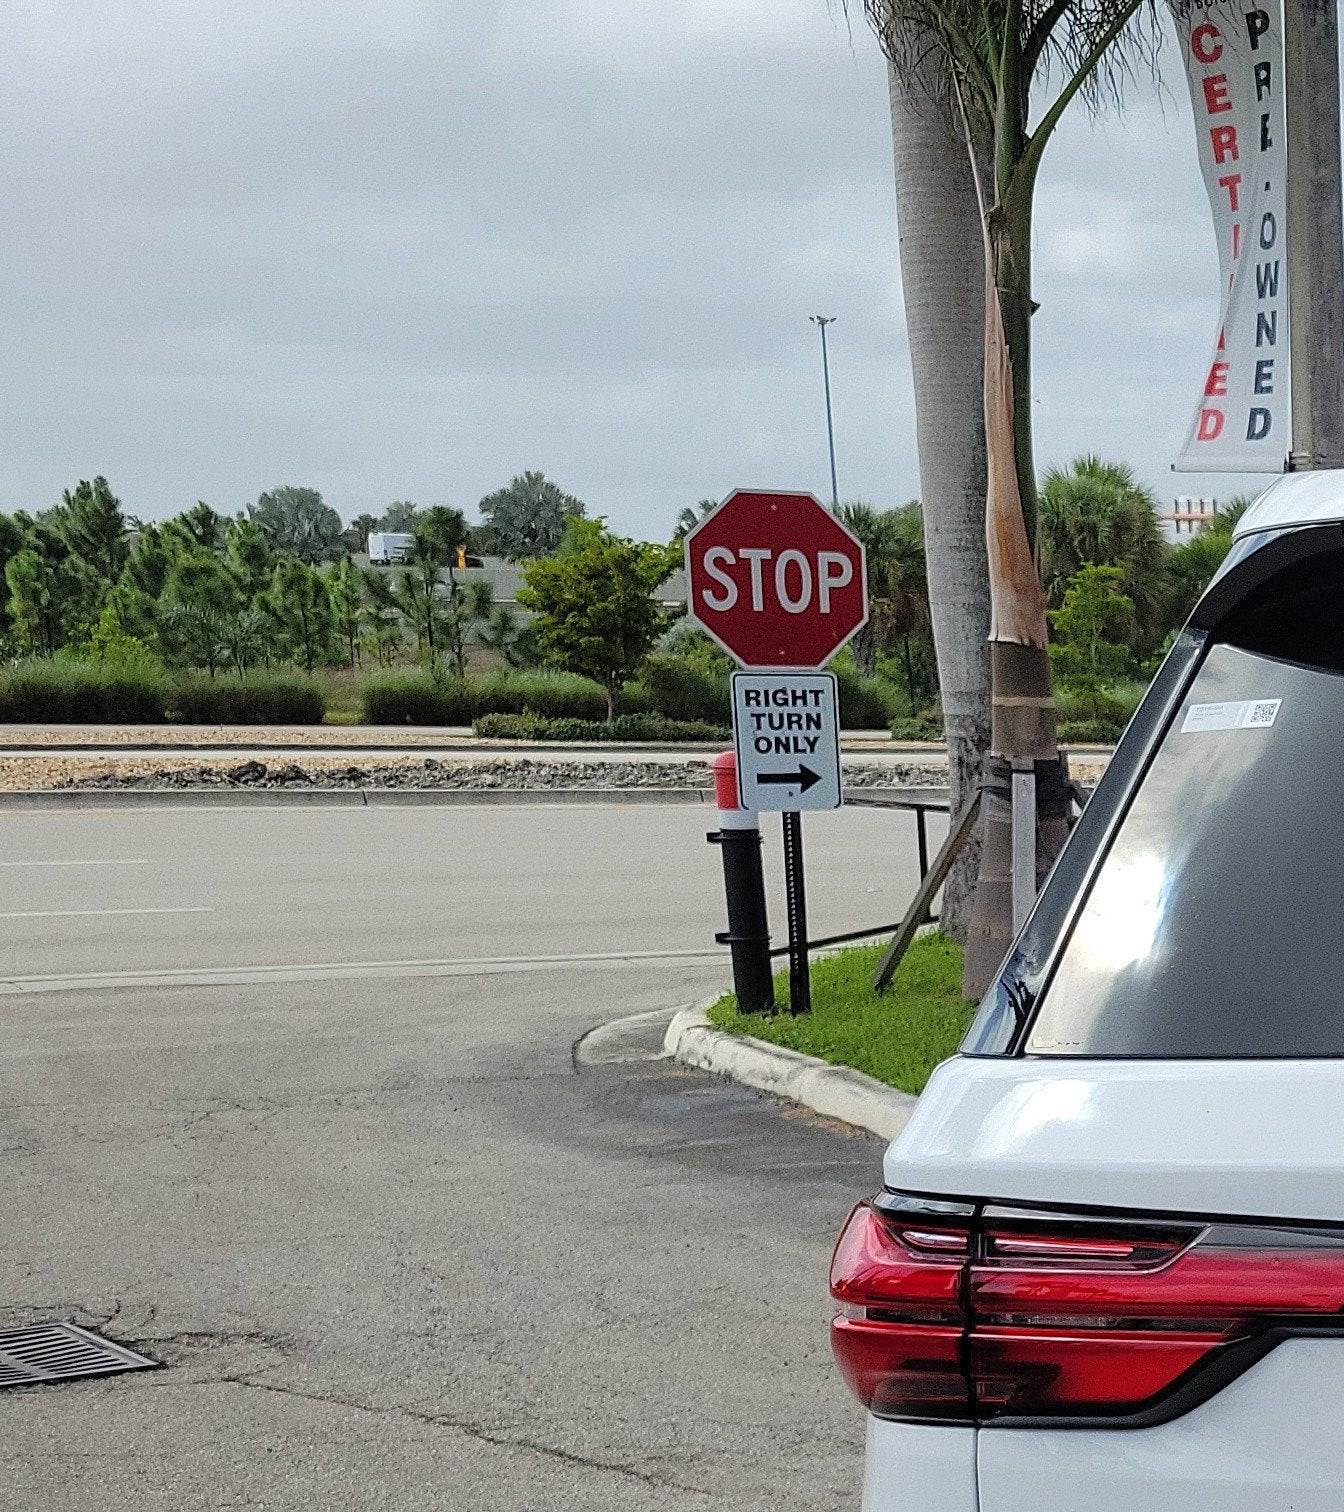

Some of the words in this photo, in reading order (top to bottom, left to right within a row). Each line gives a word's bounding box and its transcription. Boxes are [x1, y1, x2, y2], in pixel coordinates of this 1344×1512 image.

[1190, 22, 1242, 442] CERTIED
[702, 546, 853, 614] STOP
[744, 688, 825, 708] RIGHT
[750, 712, 822, 731] TURN
[754, 735, 821, 755] ONLY
